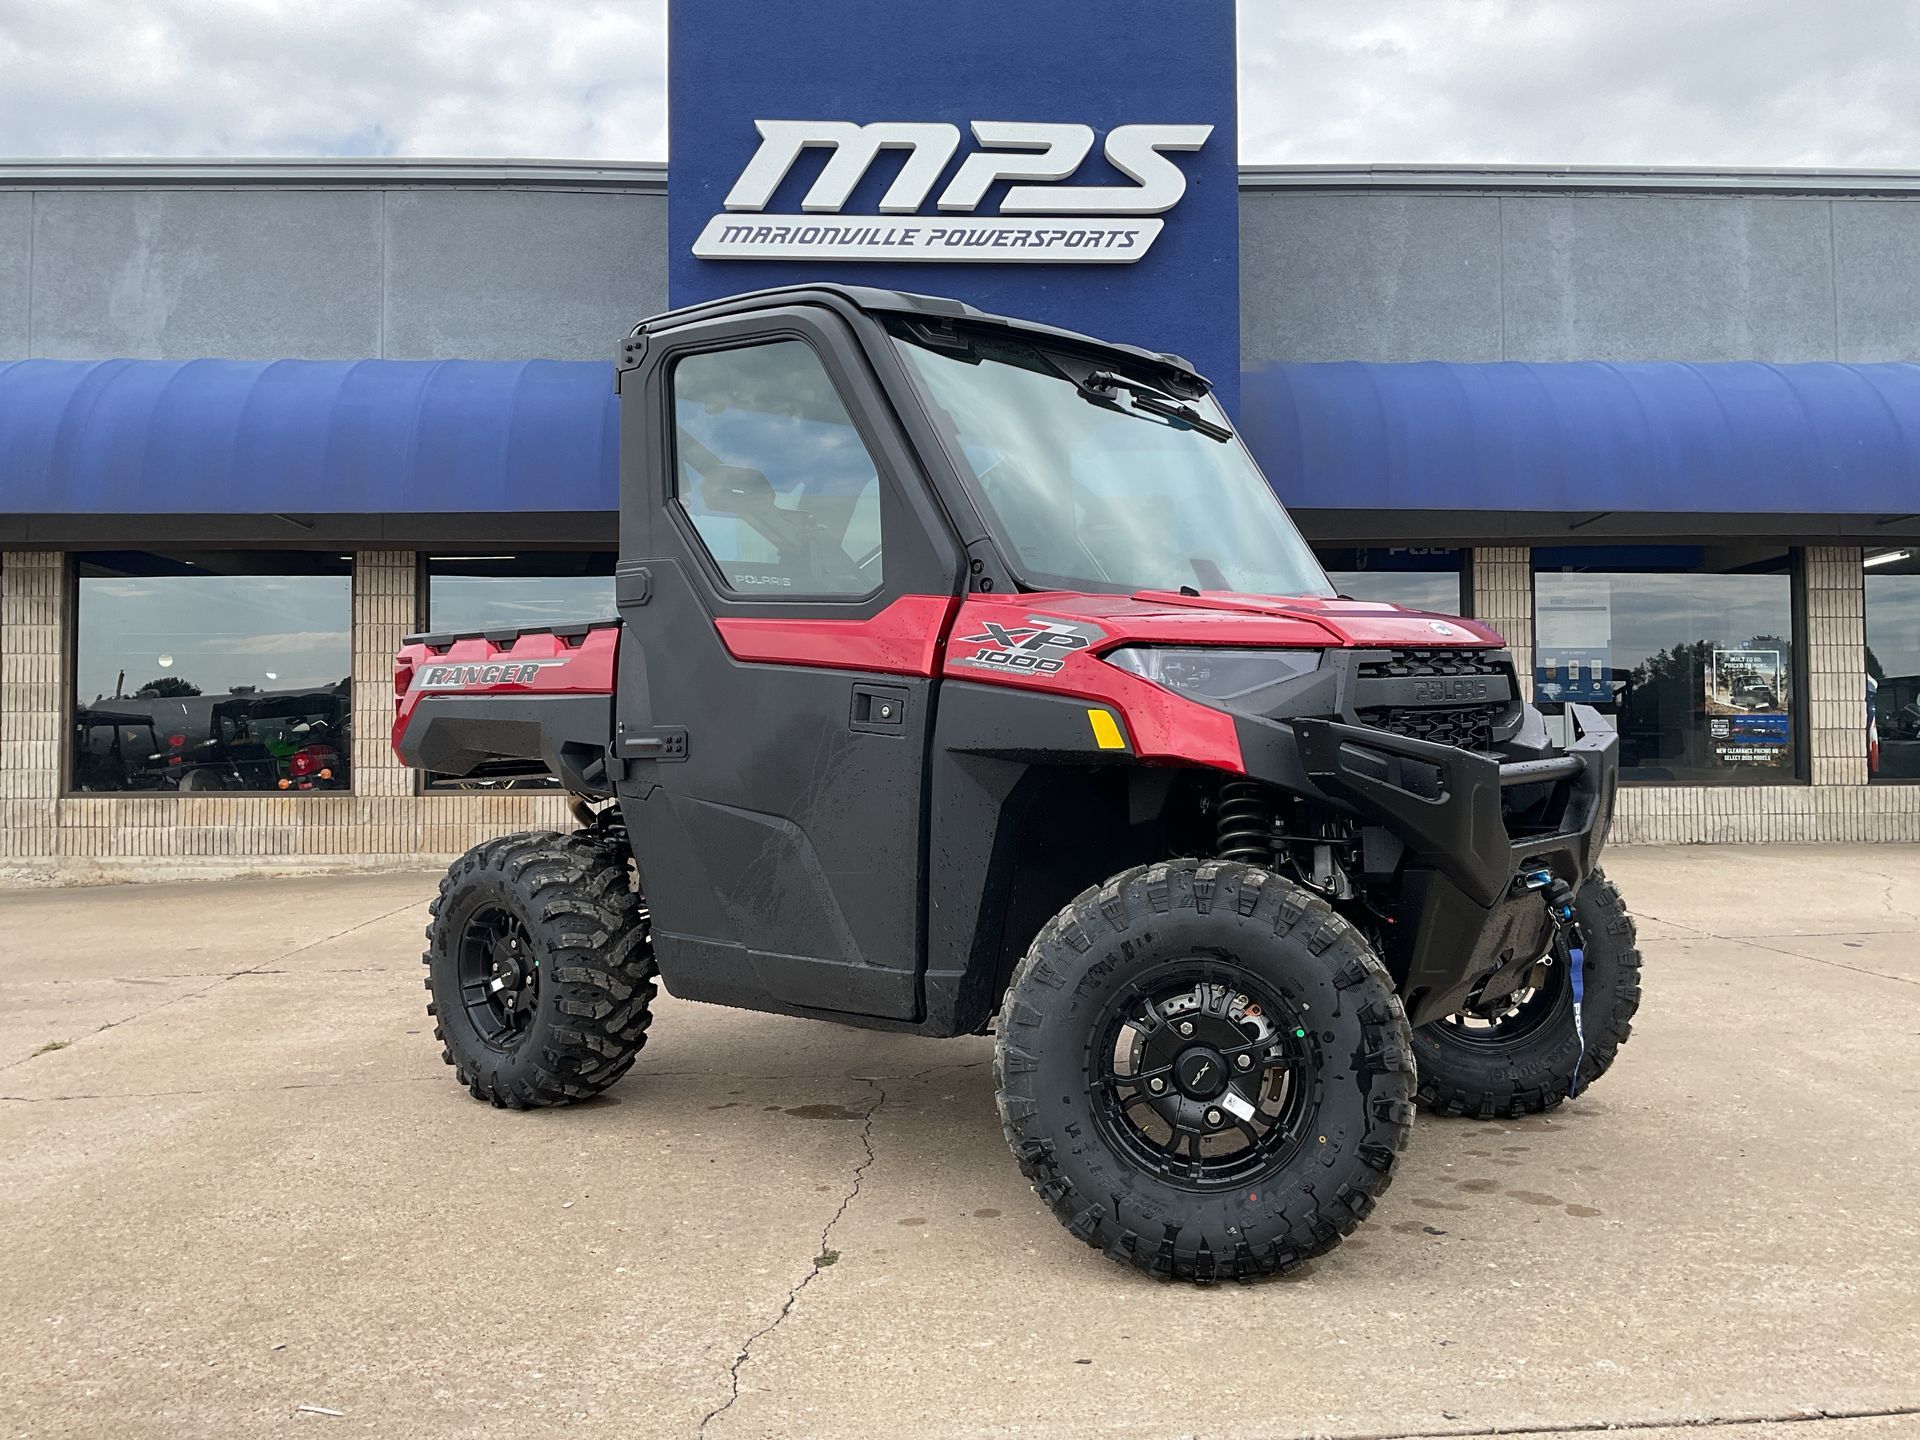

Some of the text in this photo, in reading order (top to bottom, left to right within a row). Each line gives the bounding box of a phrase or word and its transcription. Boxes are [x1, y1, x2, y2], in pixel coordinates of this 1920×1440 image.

[722, 119, 1215, 214] MPS
[718, 225, 1140, 248] MARIONVILLE POWERSPORTS
[734, 574, 792, 587] POLARIS
[955, 621, 1090, 650] XP
[972, 661, 991, 669] DUAL
[992, 665, 1035, 675] OVERHEAD
[975, 648, 1065, 672] 1000
[425, 663, 540, 686] RANGER
[1414, 679, 1487, 703] POLARIS
